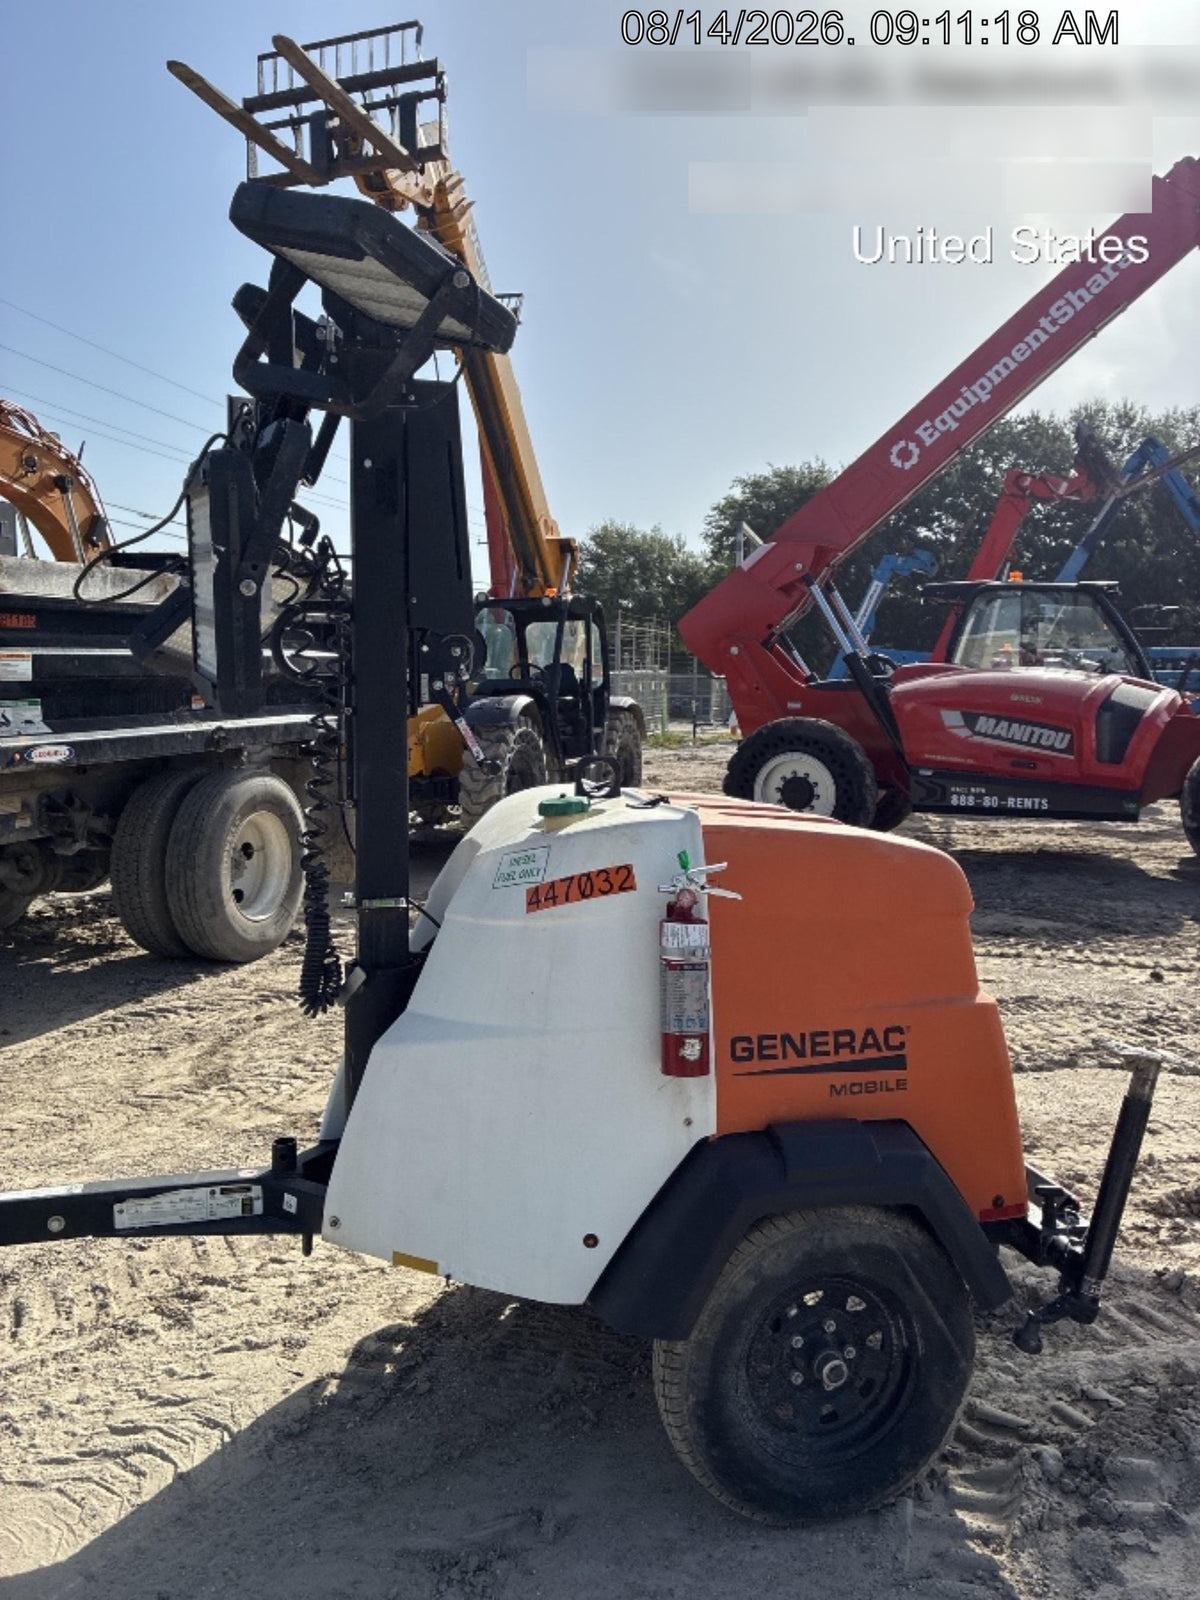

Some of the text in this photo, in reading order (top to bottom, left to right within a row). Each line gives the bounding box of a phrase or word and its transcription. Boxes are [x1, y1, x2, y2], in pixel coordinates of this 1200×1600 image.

[915, 249, 1138, 447] EquipmentShare
[975, 716, 1071, 749] MANITOU
[950, 794, 1048, 810] 888-80-RENTS
[527, 866, 634, 909] 447032
[730, 1025, 906, 1062] GENERAC
[829, 1078, 908, 1098] MOBILE
